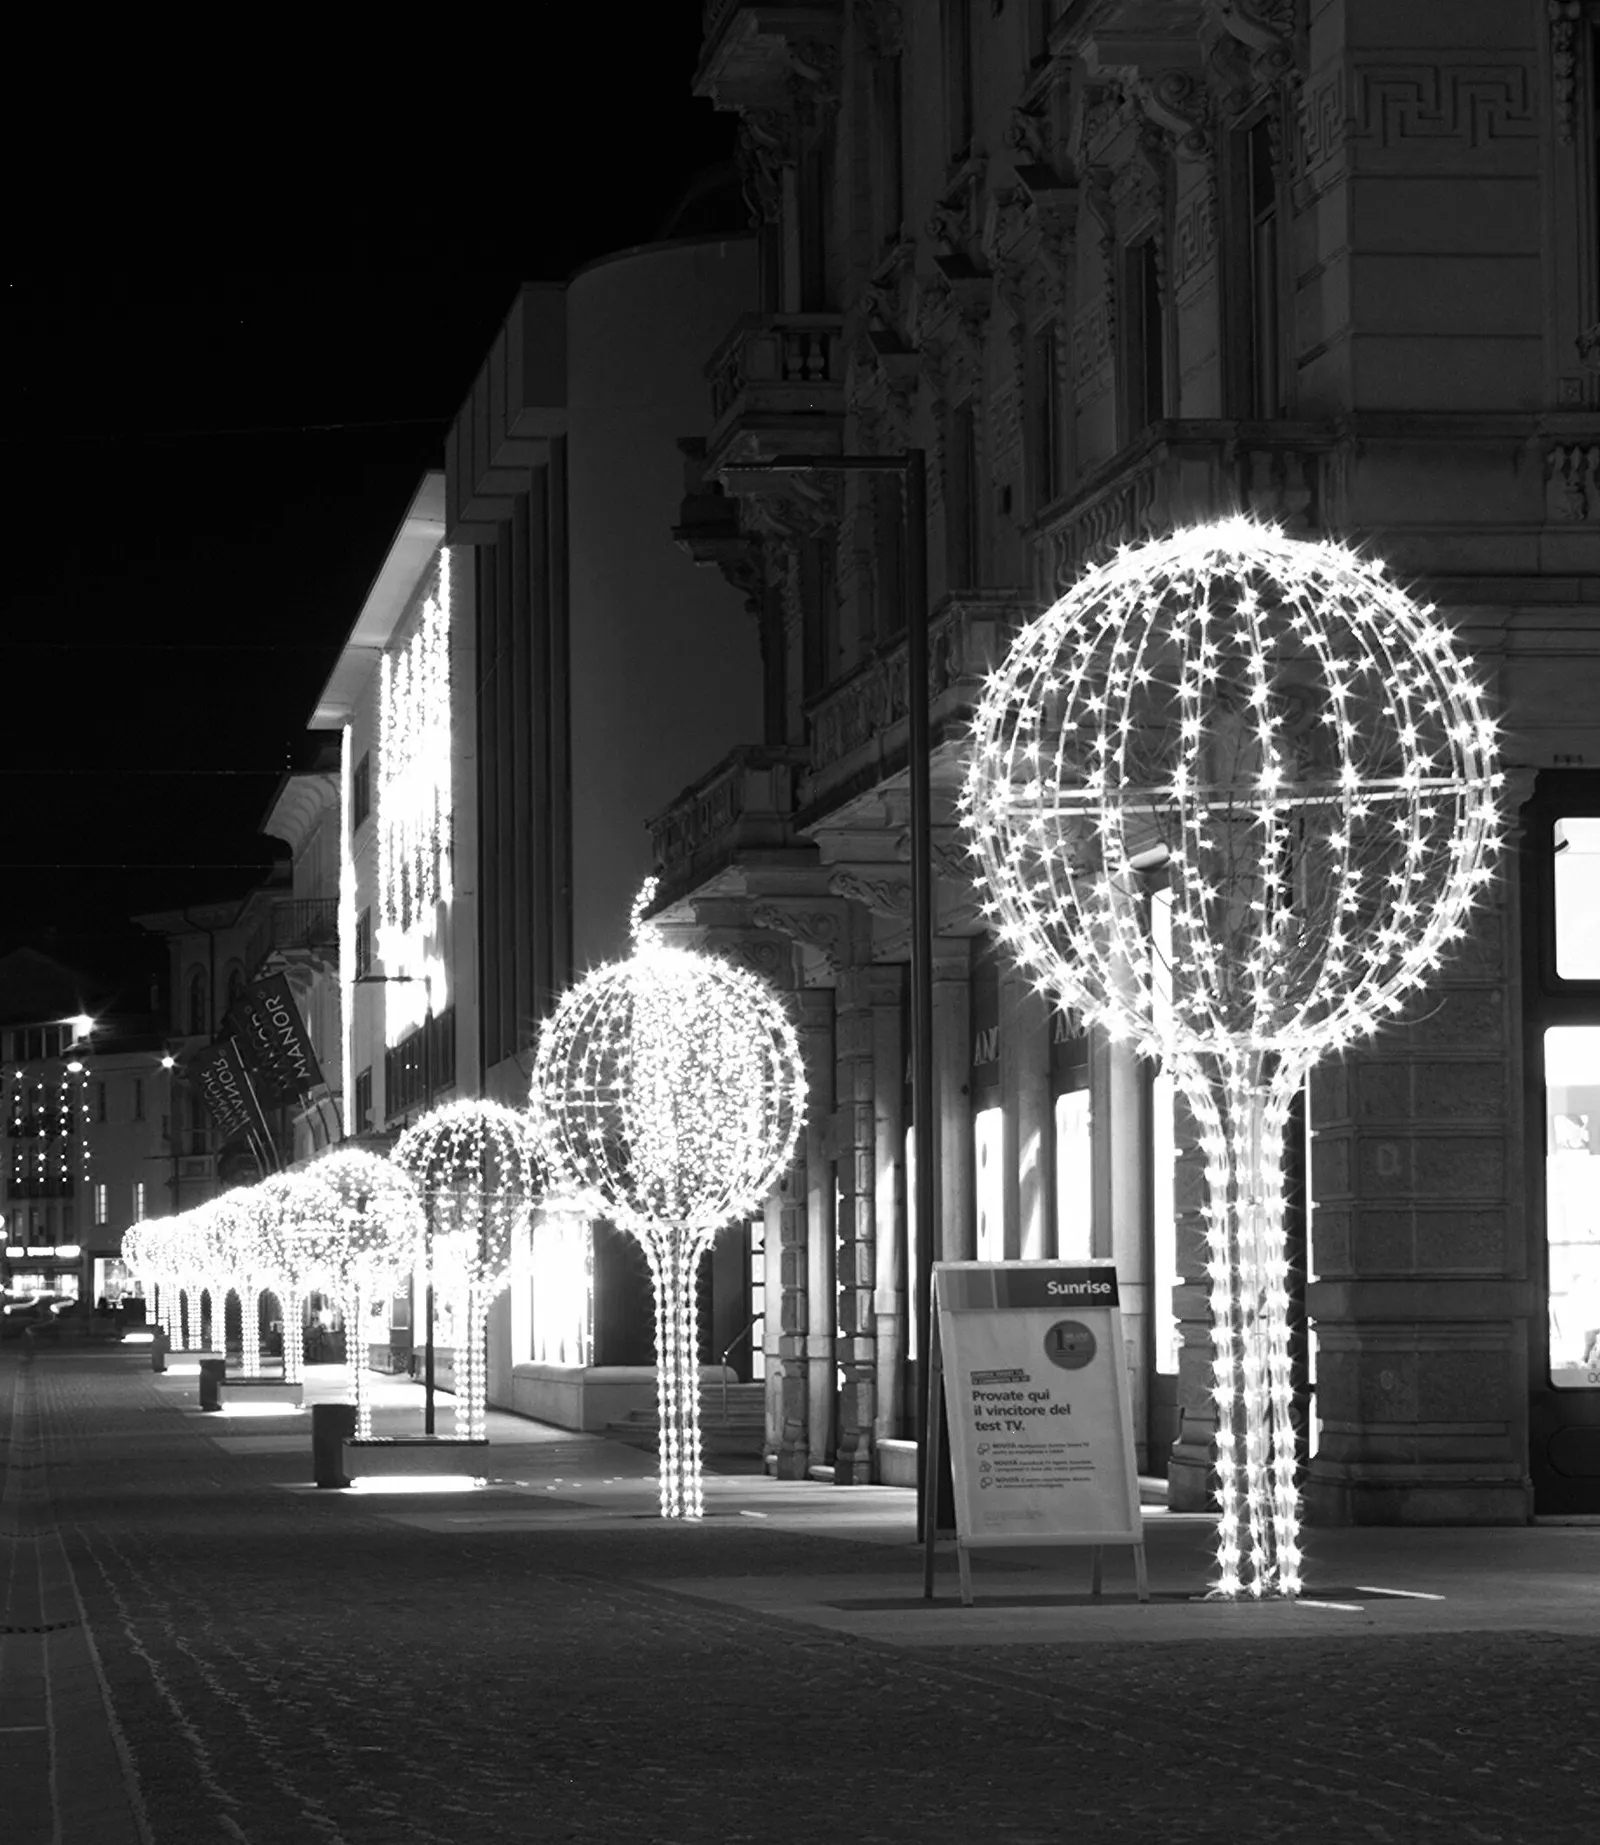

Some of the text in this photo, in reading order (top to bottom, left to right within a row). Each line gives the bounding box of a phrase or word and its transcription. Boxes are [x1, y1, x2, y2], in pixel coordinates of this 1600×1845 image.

[265, 994, 311, 1079] MANOR
[1047, 1280, 1111, 1294] Sunrise
[972, 1389, 1050, 1402] Provate qui
[974, 1404, 1071, 1416] il vincitore del
[975, 1420, 1025, 1431] test TV.
